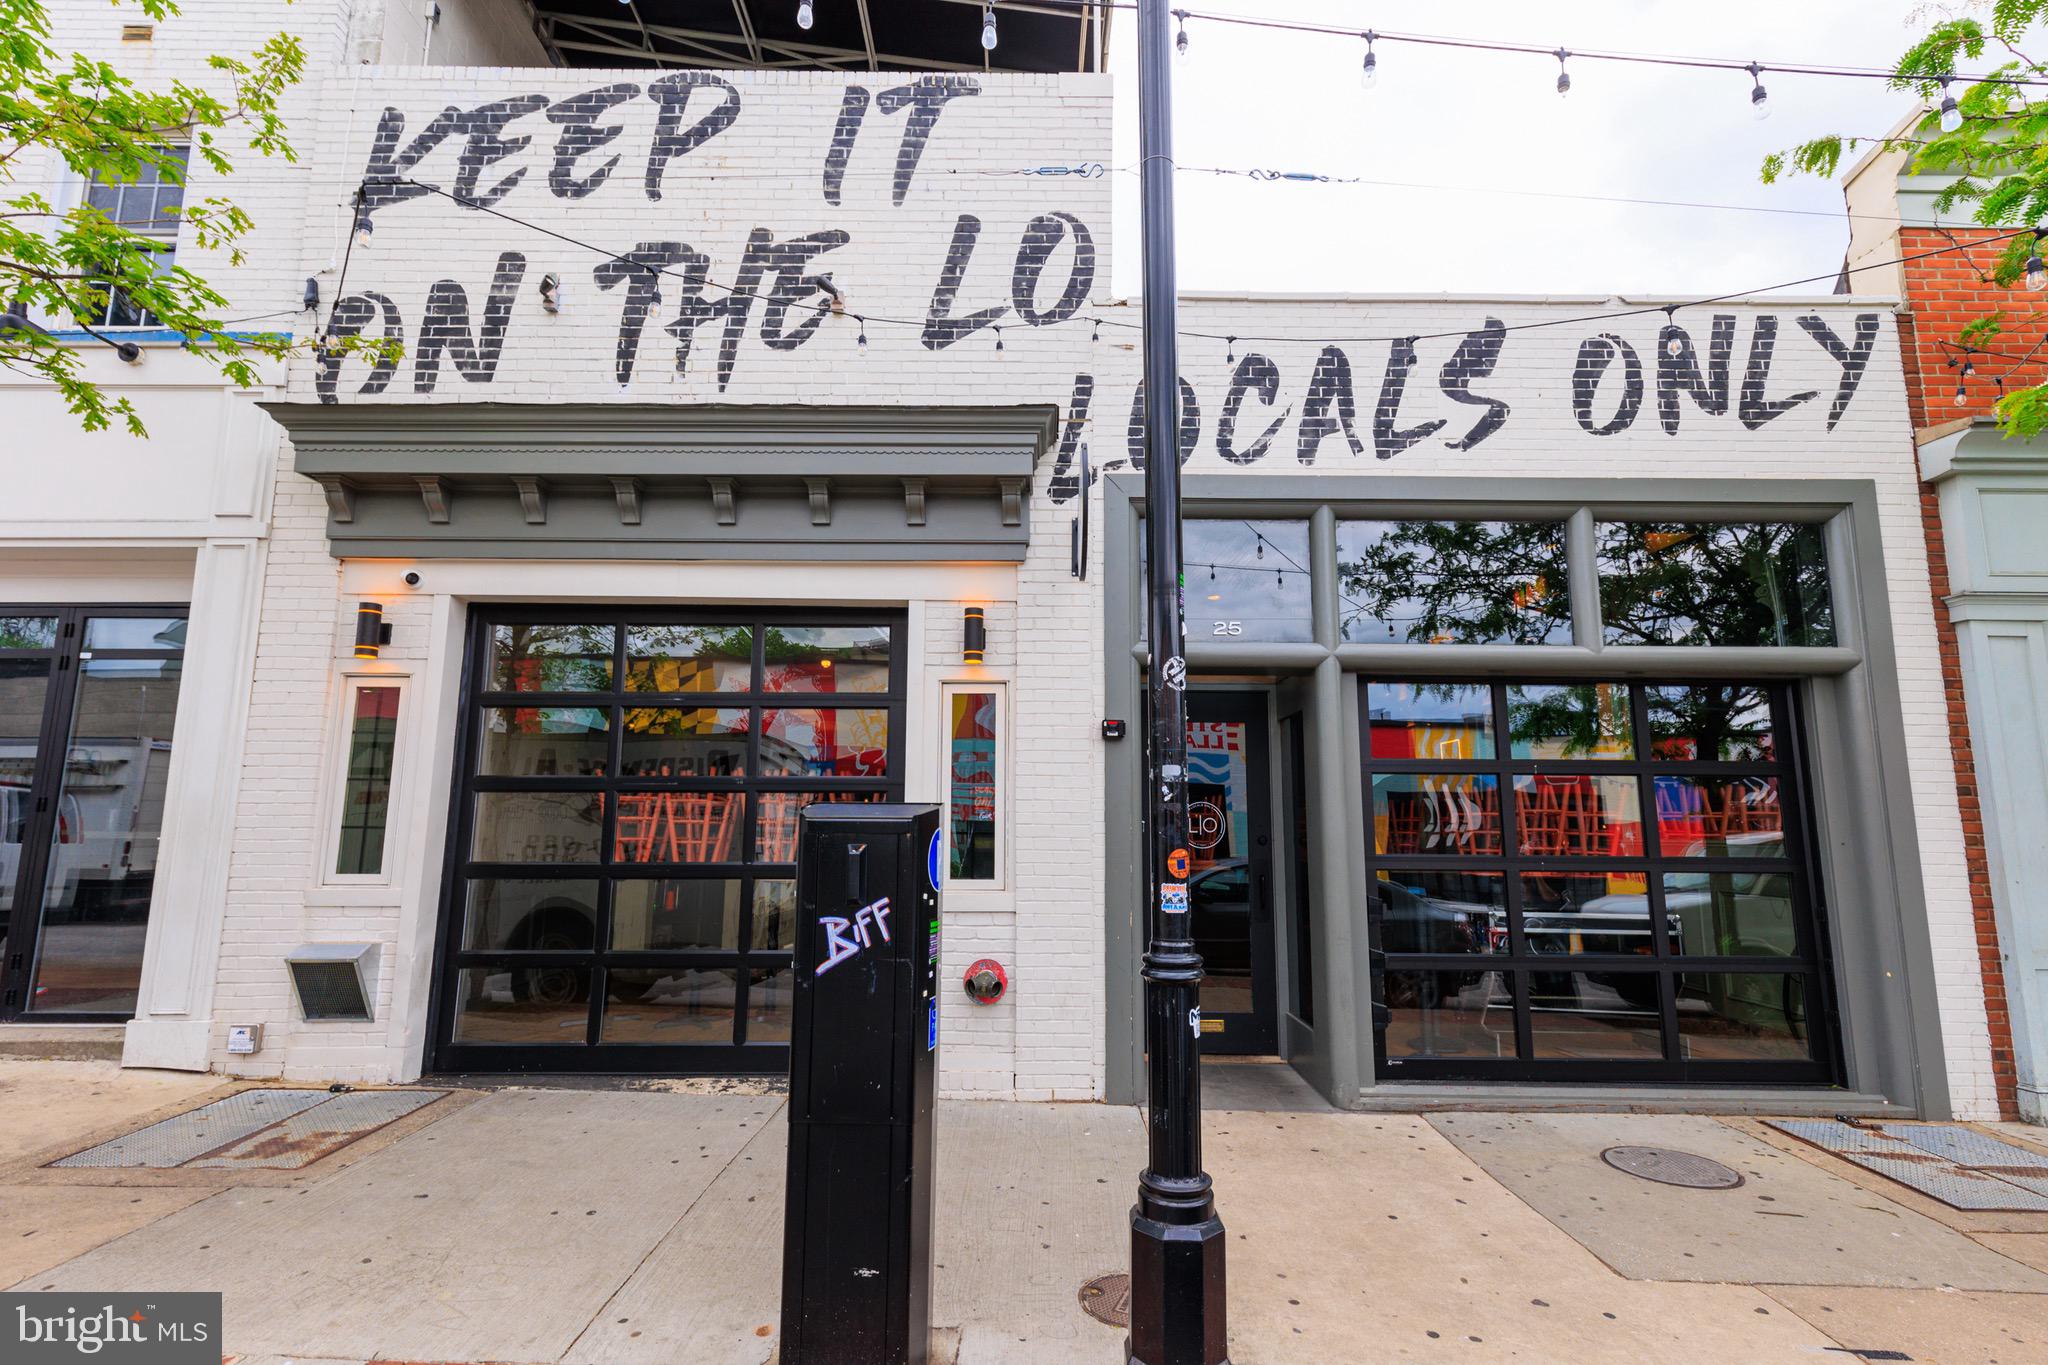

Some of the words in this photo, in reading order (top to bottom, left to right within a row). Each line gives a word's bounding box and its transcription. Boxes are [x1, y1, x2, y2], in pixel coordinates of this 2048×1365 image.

[350, 71, 741, 211] KEEP
[823, 75, 982, 207] IT
[313, 251, 526, 405] ON
[593, 228, 850, 393] THE
[921, 211, 1095, 352] LO
[1047, 316, 1511, 505] LOCALS
[1571, 314, 1881, 436] ONLY
[1212, 621, 1243, 636] 25
